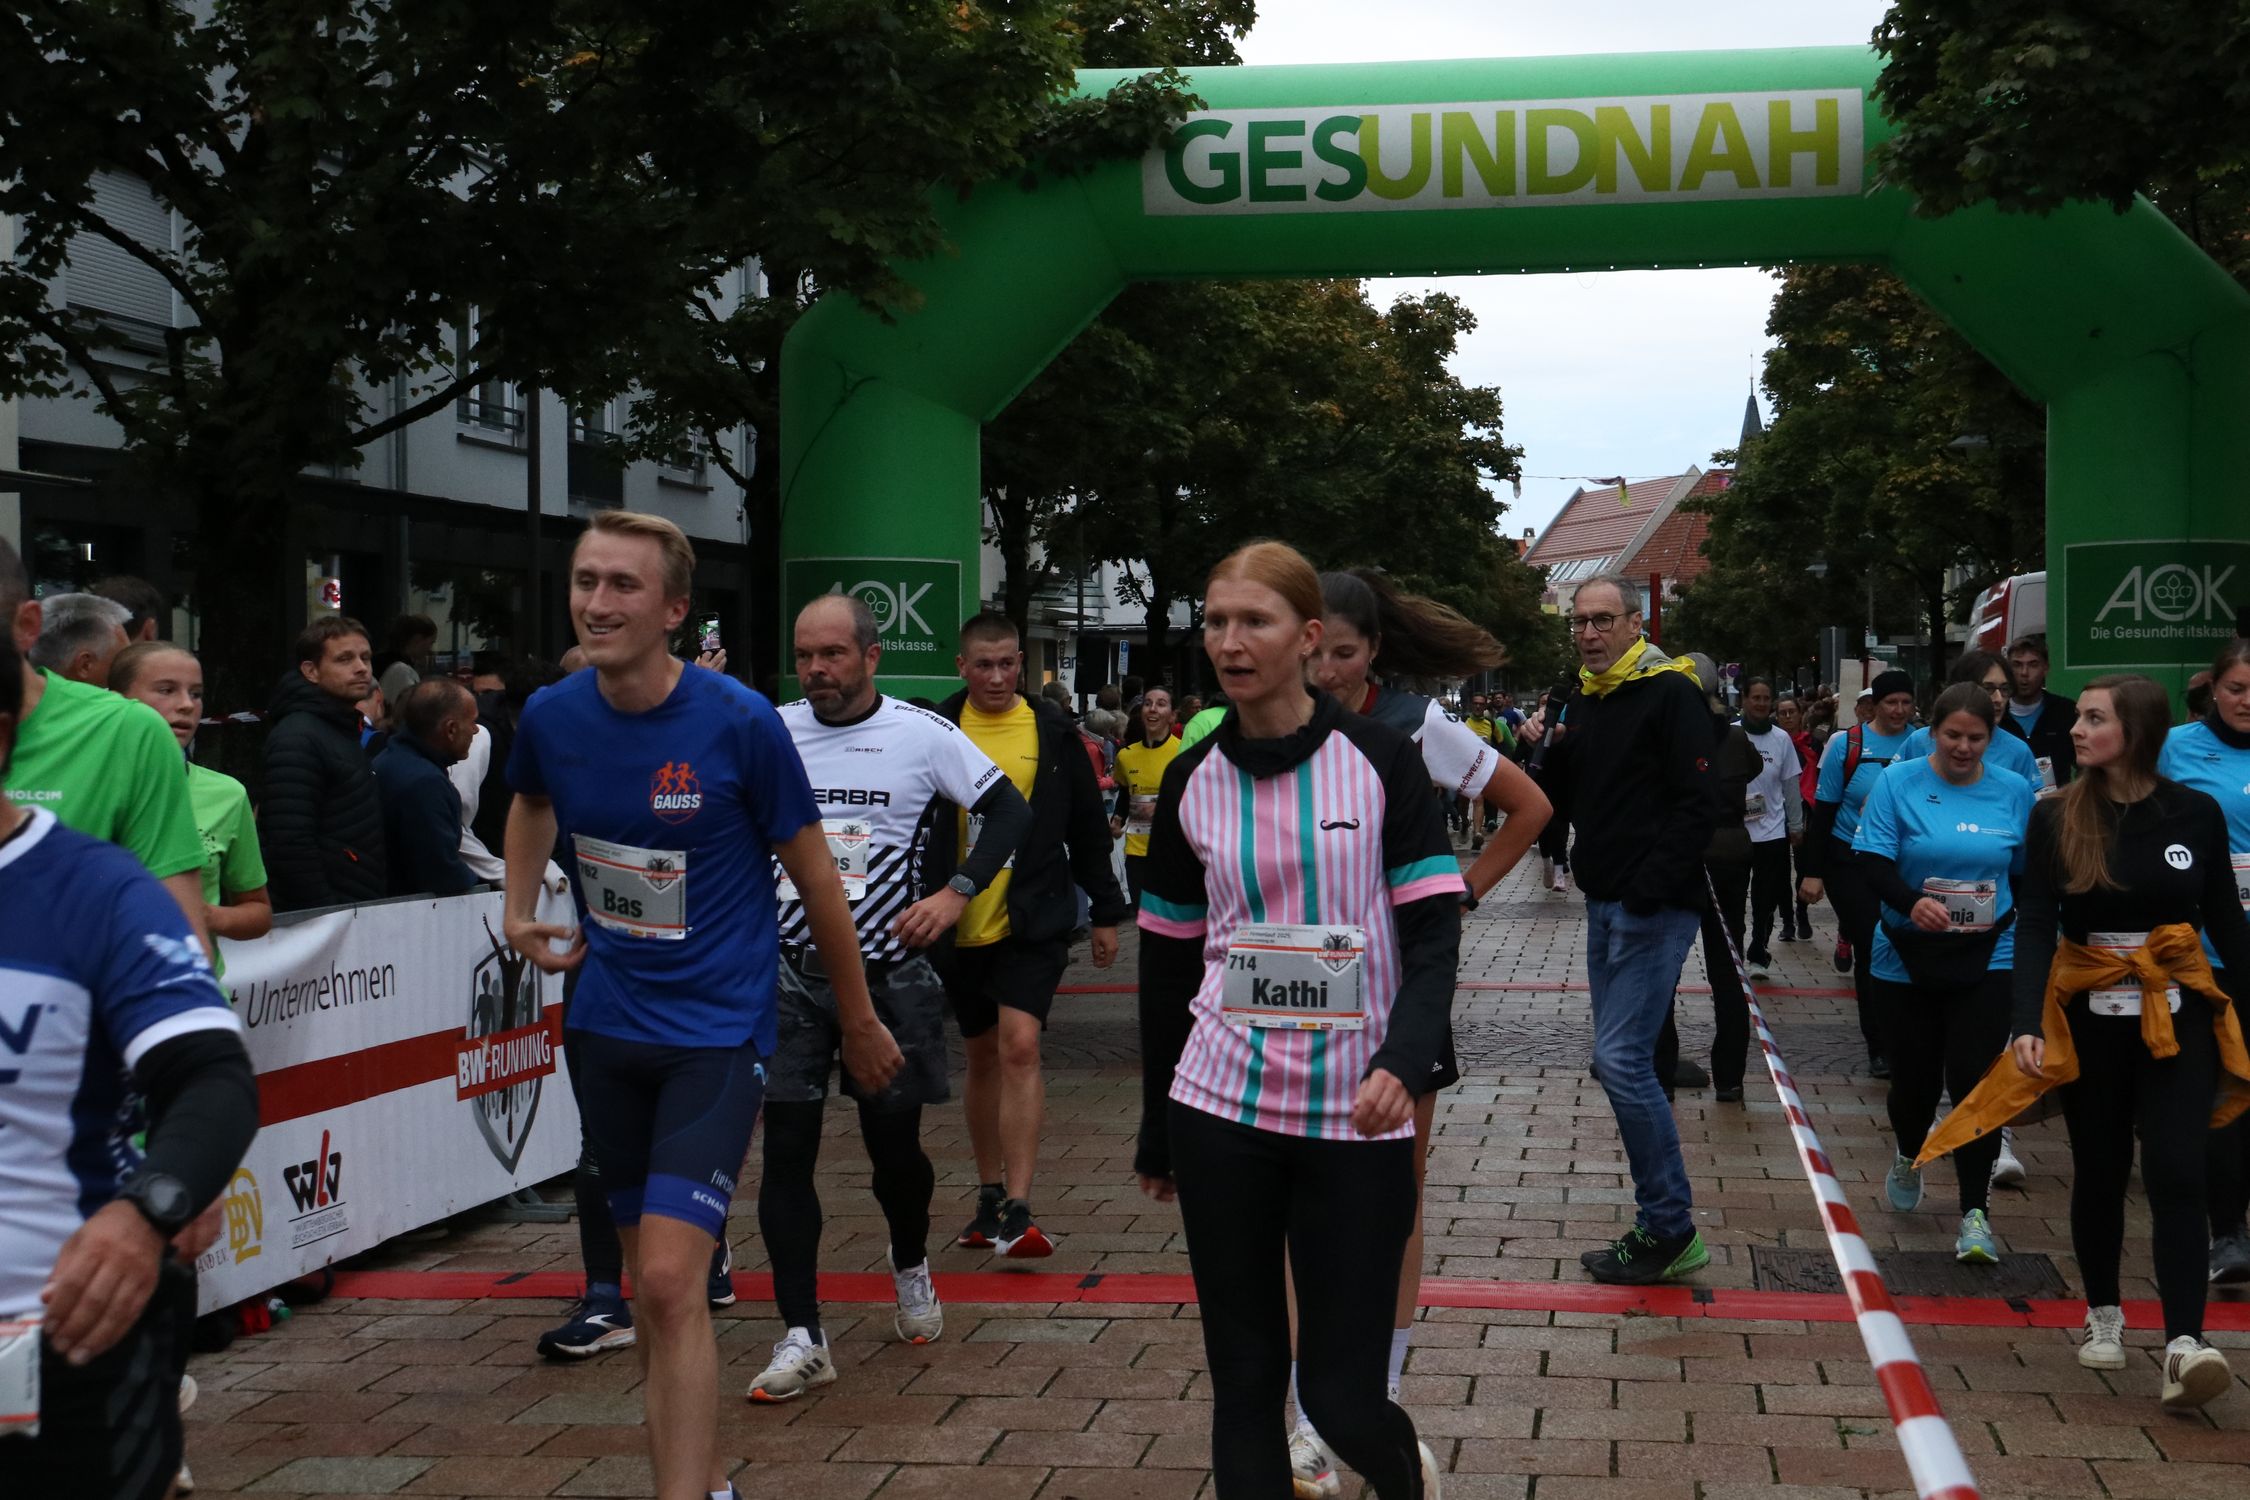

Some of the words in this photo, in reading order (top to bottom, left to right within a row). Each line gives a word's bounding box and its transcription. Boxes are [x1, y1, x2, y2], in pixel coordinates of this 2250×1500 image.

[1165, 98, 1839, 205] GESUNDNAH
[829, 581, 934, 636] OK
[2094, 564, 2237, 622] AOK
[2091, 627, 2110, 640] Die
[654, 794, 701, 810] GAUSS
[603, 887, 643, 918] Bas
[1229, 954, 1257, 971] 714
[247, 960, 395, 1029] Unternehmen
[1253, 978, 1328, 1008] Kathi
[457, 1029, 551, 1089] BW-RUNNING
